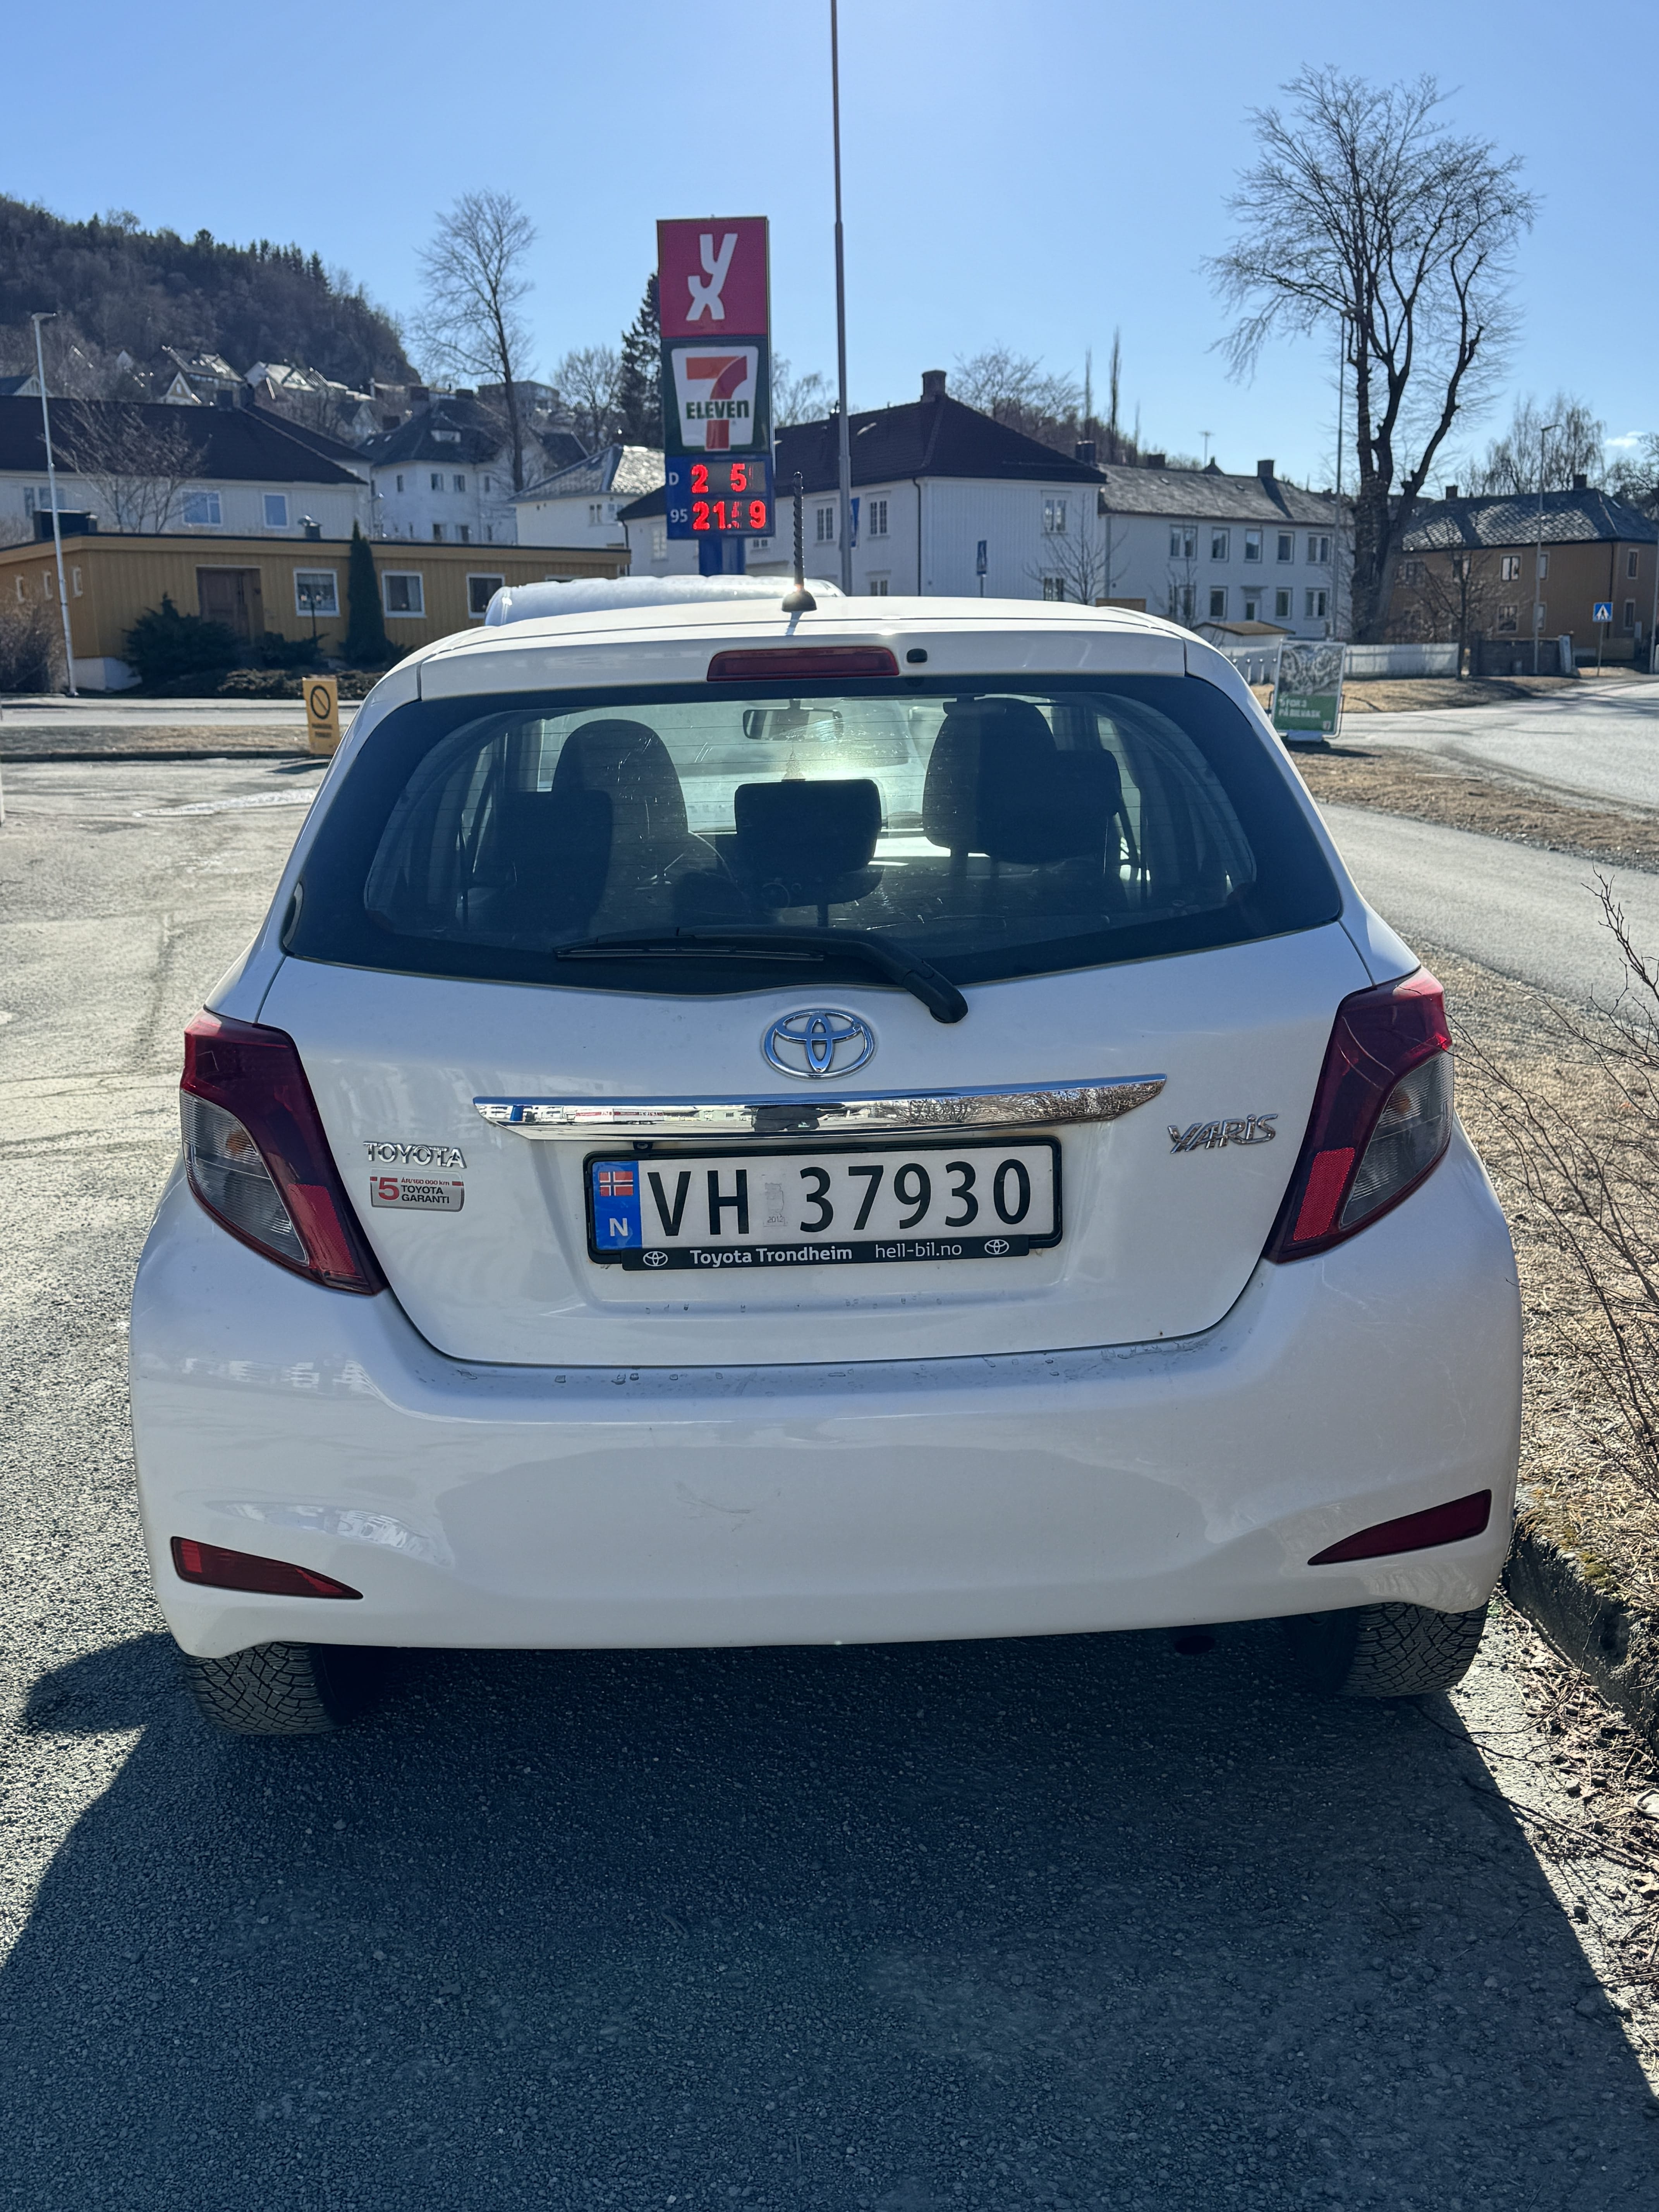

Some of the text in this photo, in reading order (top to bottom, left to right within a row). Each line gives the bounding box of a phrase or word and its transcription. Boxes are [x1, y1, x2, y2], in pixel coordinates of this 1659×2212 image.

[686, 356, 747, 450] 7
[669, 472, 679, 486] D
[670, 509, 688, 523] 95
[363, 1141, 467, 1169] TOYOTA
[378, 1177, 400, 1200] 5
[401, 1185, 443, 1195] TOYOTA
[647, 1159, 1031, 1237] VH 37930
[401, 1194, 450, 1204] GARANTI
[609, 1218, 629, 1237] N
[690, 1246, 852, 1267] Toyota Trondheim
[875, 1242, 962, 1258] hell-bil.no
